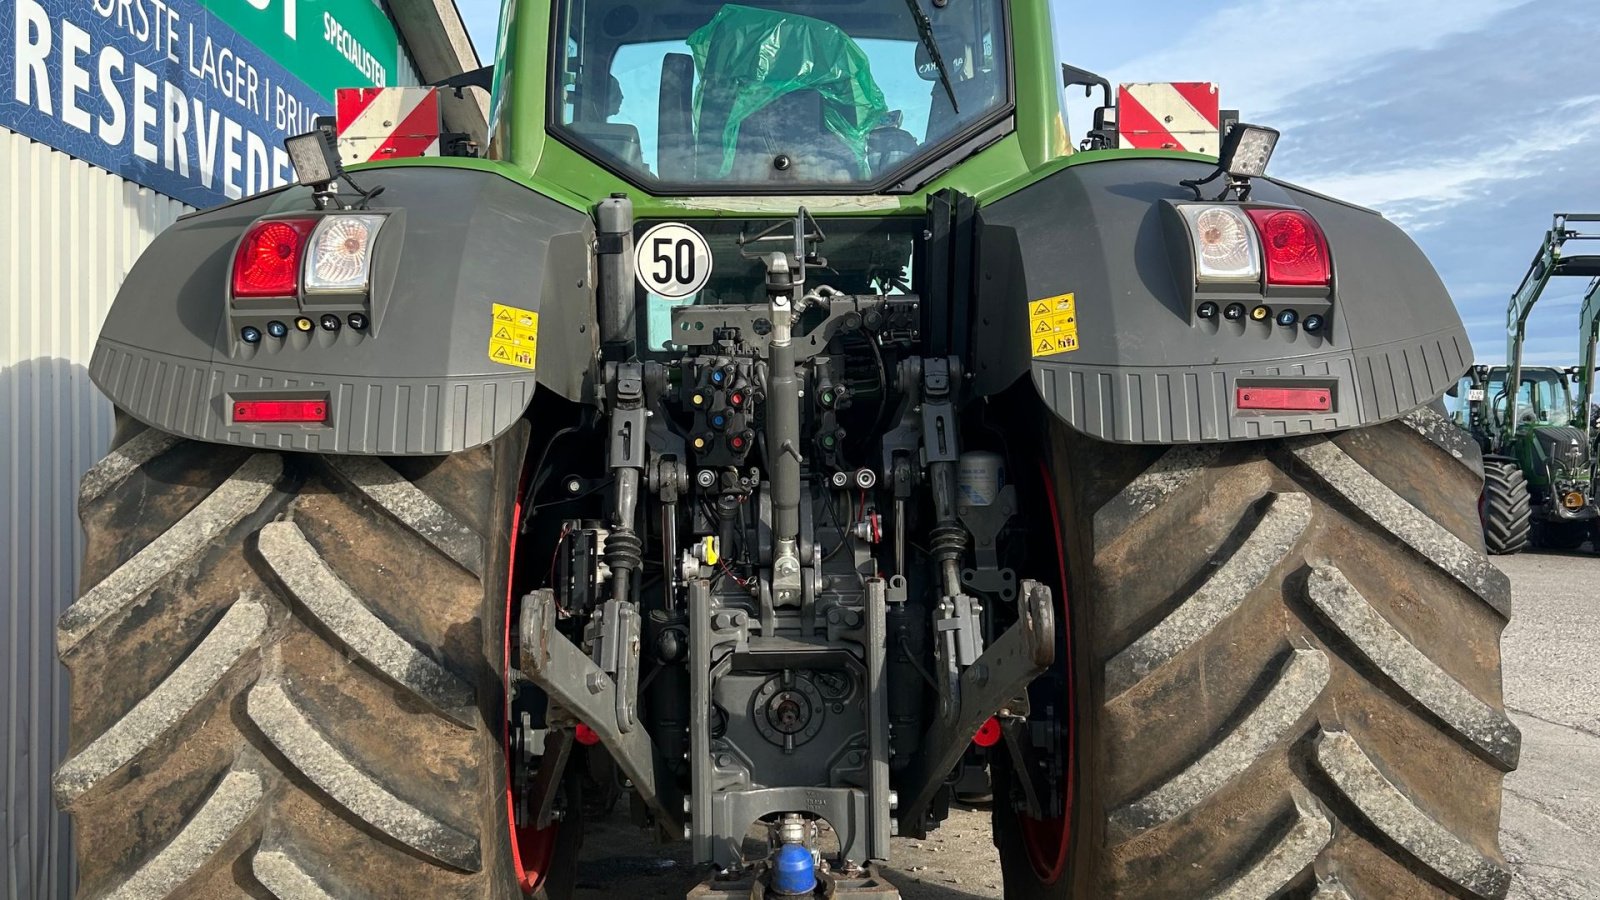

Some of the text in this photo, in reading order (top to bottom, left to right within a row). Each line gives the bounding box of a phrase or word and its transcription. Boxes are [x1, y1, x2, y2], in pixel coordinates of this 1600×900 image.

[189, 22, 259, 115] LAGER
[265, 78, 270, 122] I
[323, 11, 386, 88] SPECIALISTEN
[16, 0, 299, 201] RESERVEDE
[652, 238, 695, 284] 50
